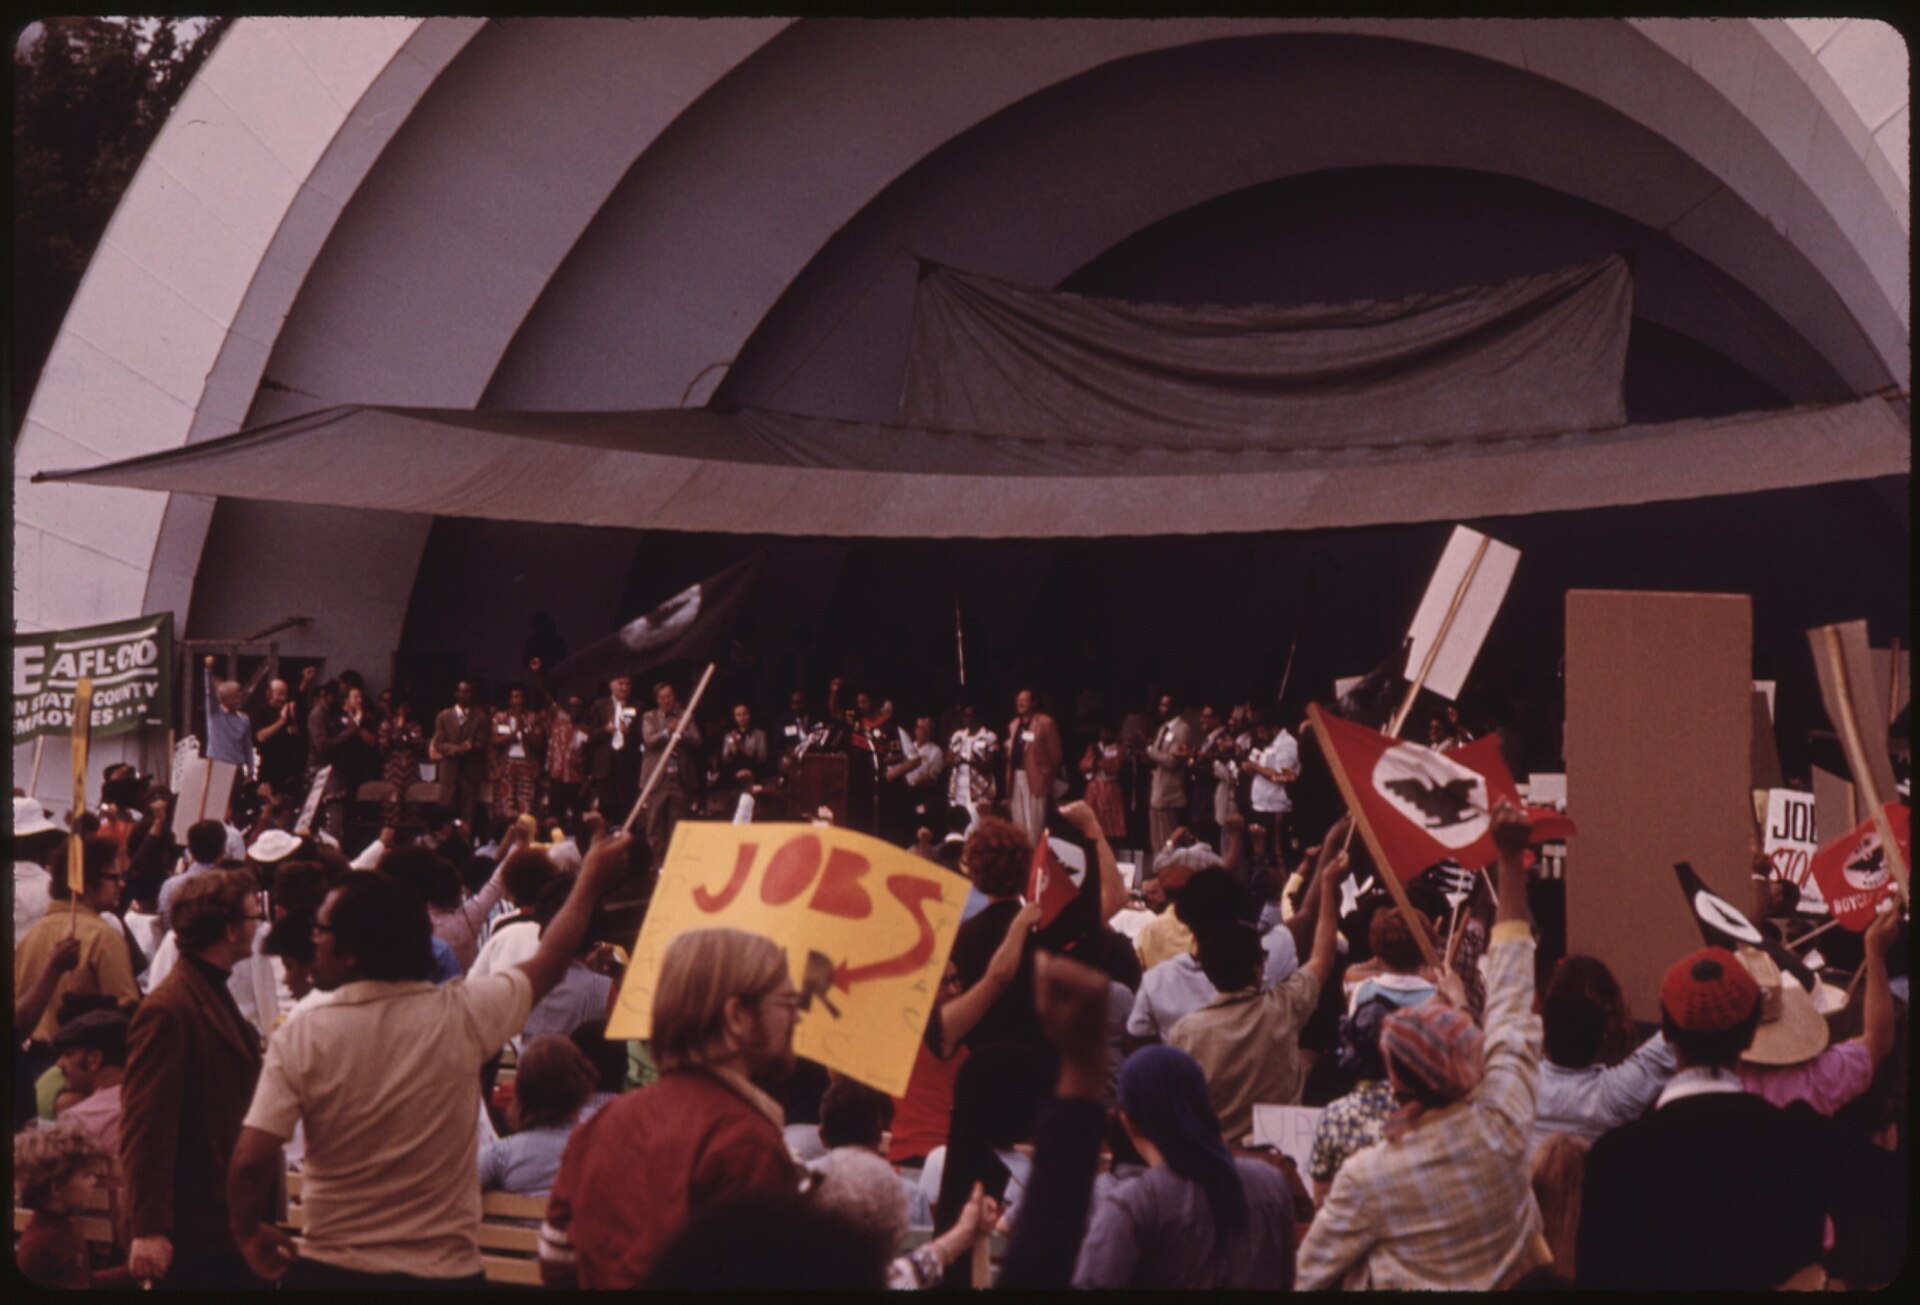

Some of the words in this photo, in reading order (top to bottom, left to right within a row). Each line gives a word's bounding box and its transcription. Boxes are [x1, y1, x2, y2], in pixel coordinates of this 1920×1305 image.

[31, 692, 78, 712] STAT
[93, 682, 159, 706] COUNTY
[692, 833, 943, 984] JOBS
